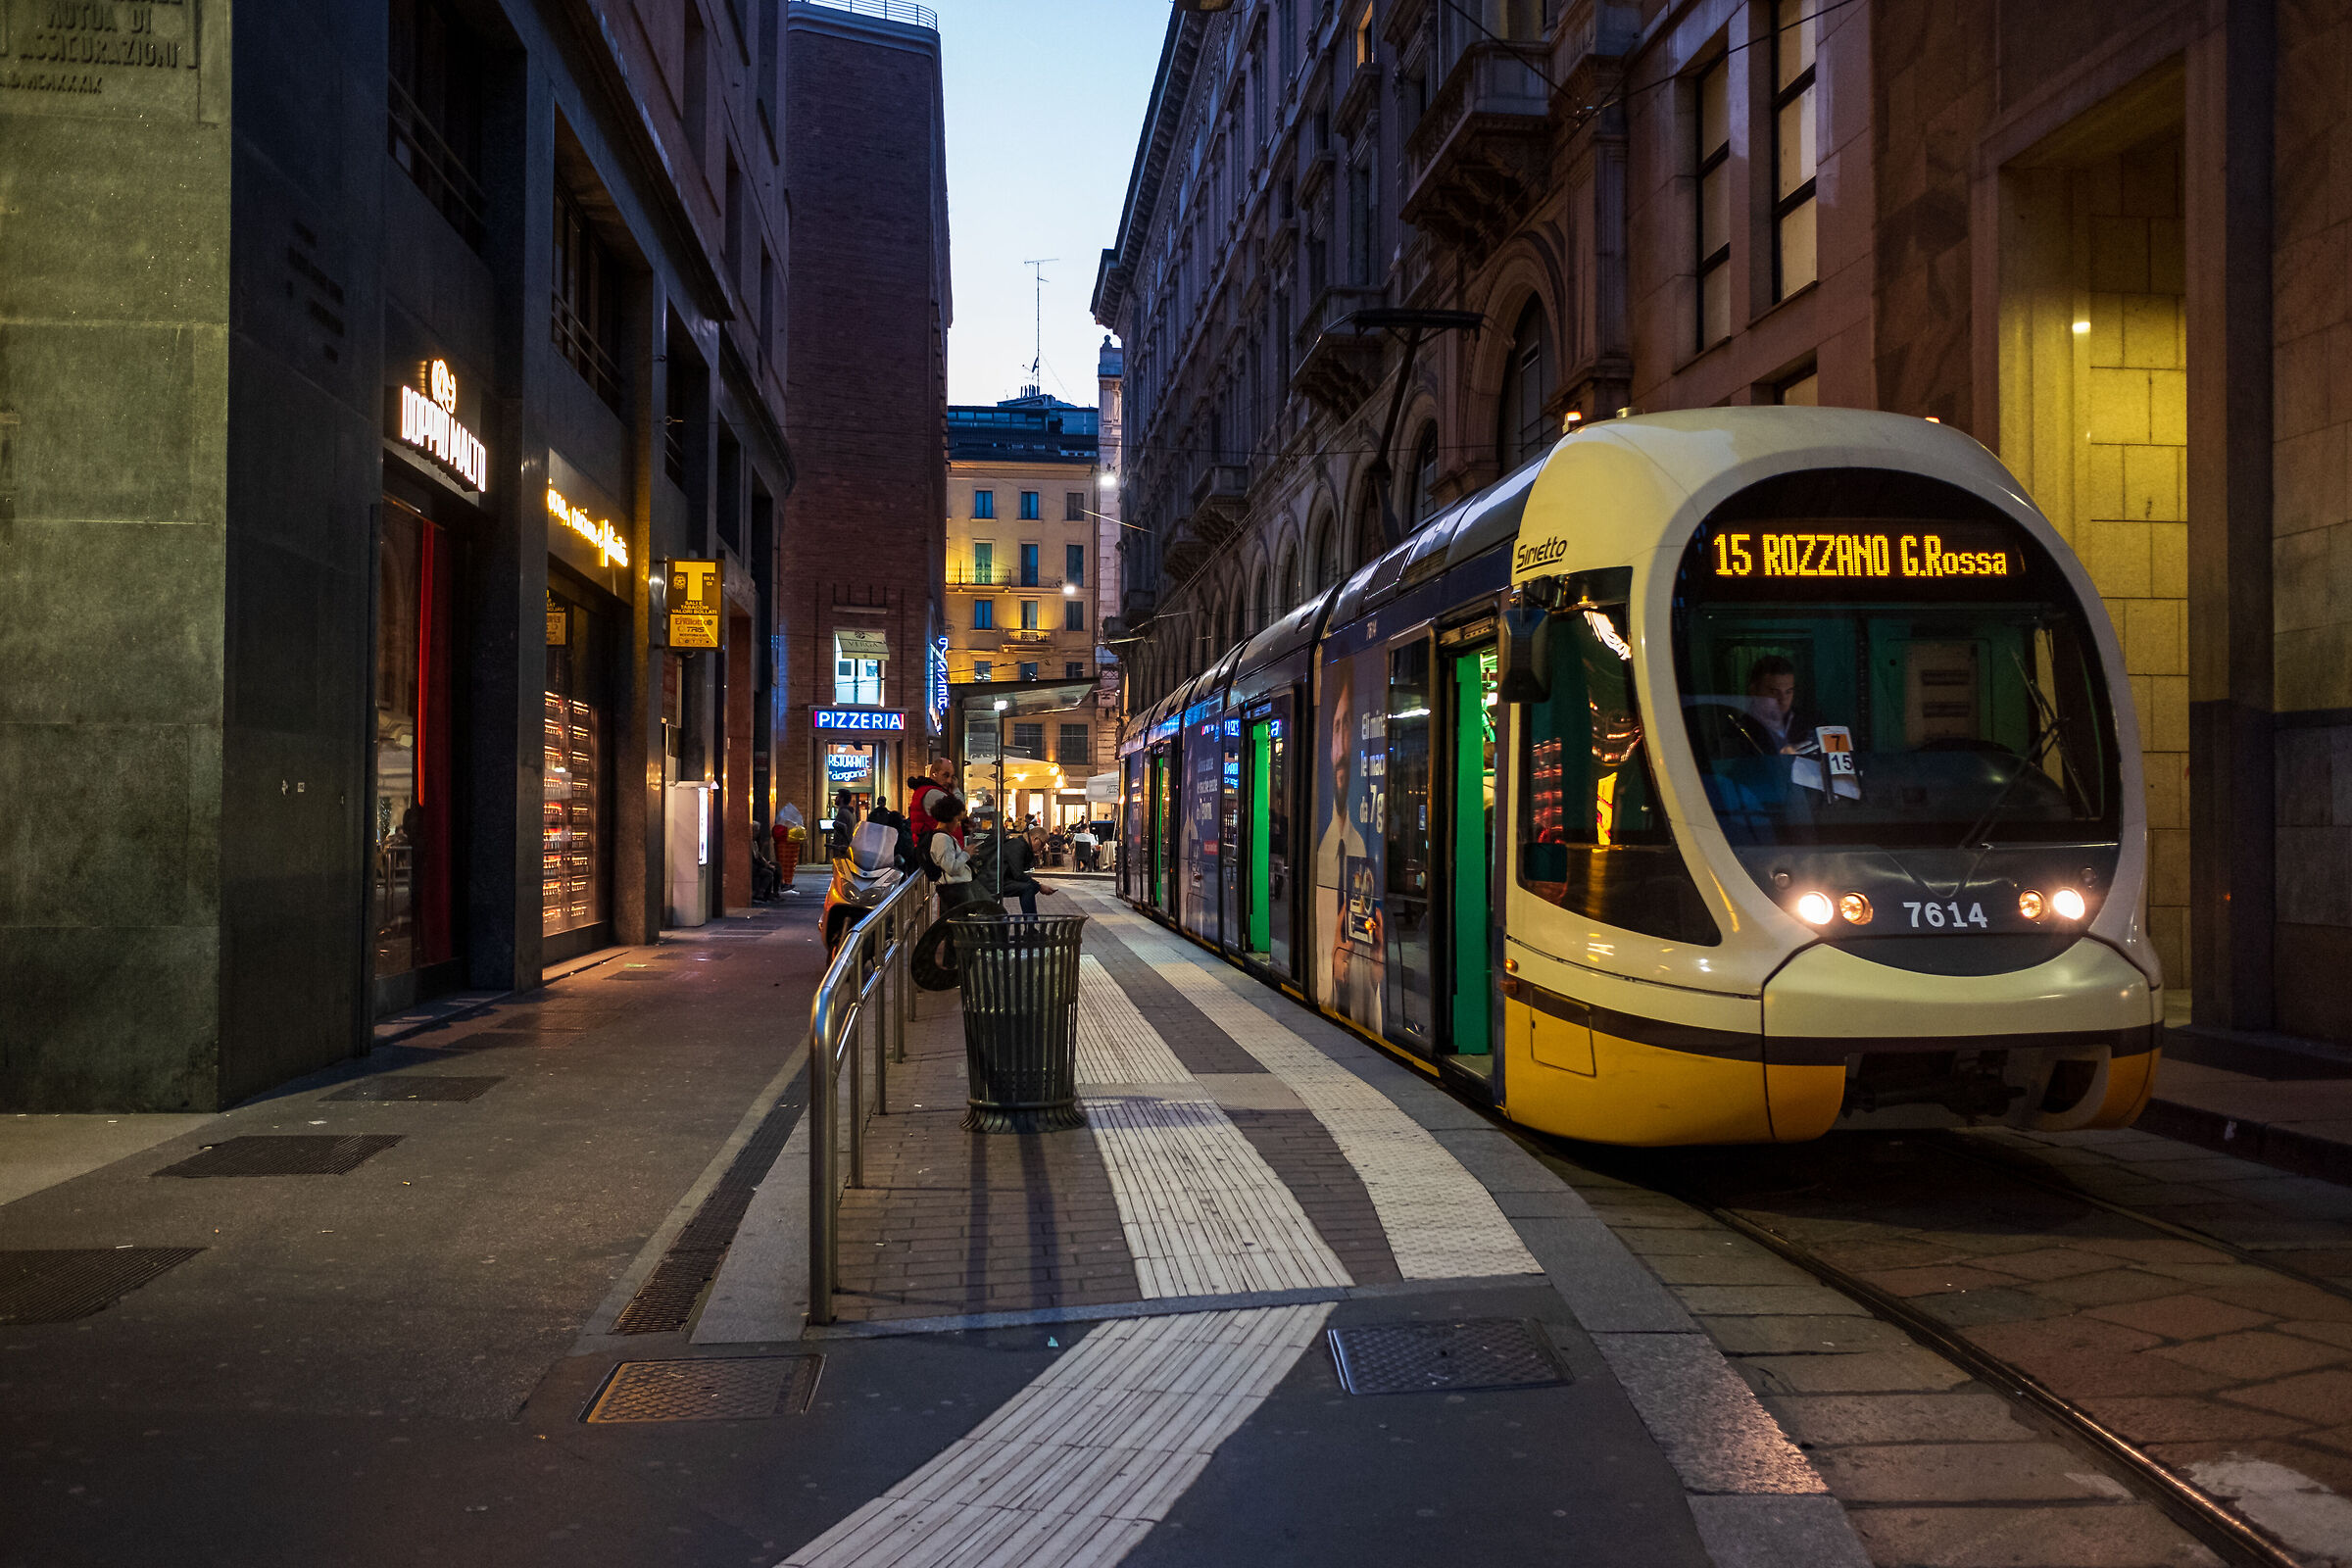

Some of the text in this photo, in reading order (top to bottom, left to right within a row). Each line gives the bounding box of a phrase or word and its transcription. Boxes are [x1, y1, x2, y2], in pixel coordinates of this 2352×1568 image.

[47, 2, 151, 34] MUTUA DI
[20, 34, 178, 69] ASSICURAZIONI
[401, 384, 486, 493] DOPPIO MALTO
[1714, 534, 2007, 576] 15 ROZZANO G.Rossa
[675, 562, 715, 601] T
[819, 711, 902, 729] PIZZERIA
[1831, 735, 1840, 751] 7
[828, 755, 870, 768] RISTORANTE
[1832, 755, 1852, 770] 15
[1902, 902, 1987, 928] 7614
